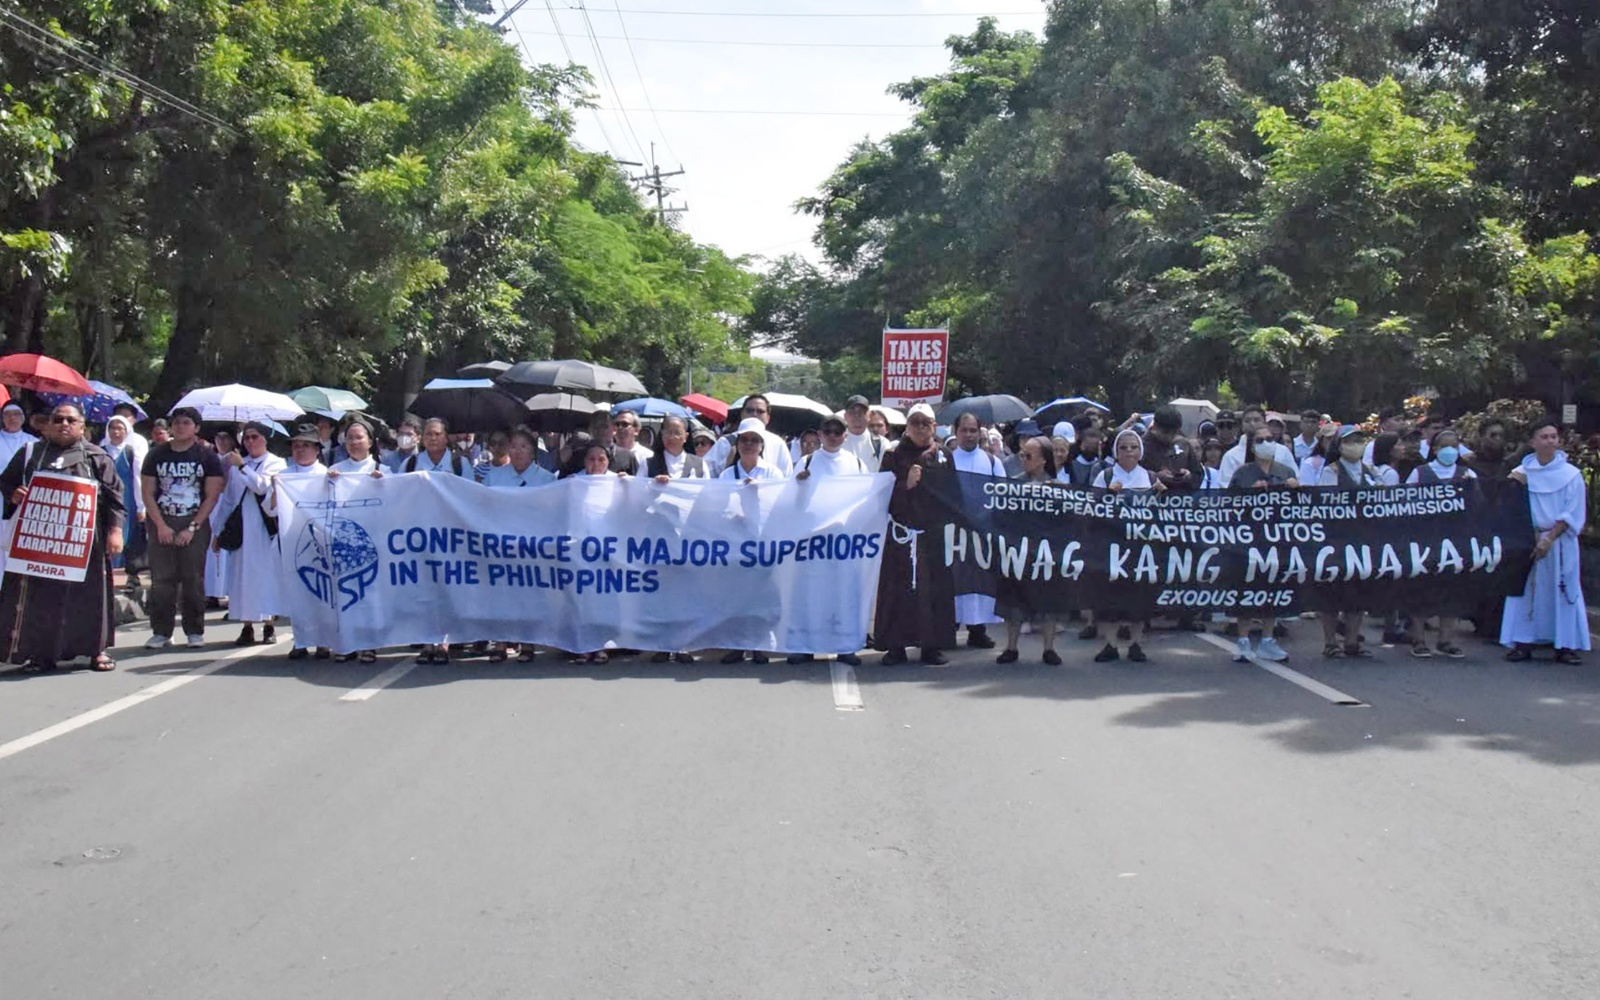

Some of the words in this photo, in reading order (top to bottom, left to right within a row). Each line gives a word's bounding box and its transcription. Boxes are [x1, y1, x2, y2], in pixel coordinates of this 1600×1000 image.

[888, 340, 942, 360] TAXES
[887, 361, 913, 375] NOT
[917, 361, 942, 375] FOR
[887, 376, 940, 391] THIEVES!
[28, 486, 74, 507] NAKAW
[76, 493, 92, 510] SA
[983, 482, 1095, 502] CONFERENCE
[1102, 494, 1125, 505] OF
[1132, 494, 1194, 508] MAJOR
[1199, 491, 1292, 508] SUPERIORS
[1297, 492, 1312, 504] IN
[1320, 491, 1350, 505] THE
[24, 502, 70, 524] KABAN
[72, 510, 90, 528] AY
[983, 496, 1060, 516] JUSTICE,
[1062, 501, 1114, 519] PEACE
[1119, 507, 1153, 521] AND
[1158, 508, 1245, 523] INTEGRITY
[1251, 507, 1274, 521] OF
[1280, 505, 1357, 520] CREATION
[1362, 498, 1465, 518] COMMISSION
[20, 518, 68, 540] NAKAW
[70, 526, 88, 543] NG
[1126, 522, 1254, 545] IKAPITONG
[1264, 522, 1326, 543] UTOS
[17, 535, 85, 557] KARAPATAN!
[387, 527, 572, 562] CONFERENCE
[580, 536, 618, 563] OF
[626, 537, 730, 567] MAJOR
[739, 532, 881, 568] SUPERIORS
[944, 522, 1084, 582] HUWAG
[1109, 542, 1221, 584] KANG
[1245, 535, 1502, 584] MAGNAKAW
[26, 563, 66, 577] PAHRA
[390, 560, 418, 586] IN
[424, 560, 480, 585] THE
[488, 564, 660, 595] PHILIPPINES
[1156, 589, 1237, 607] EXODUS
[1241, 589, 1294, 607] 20:15
